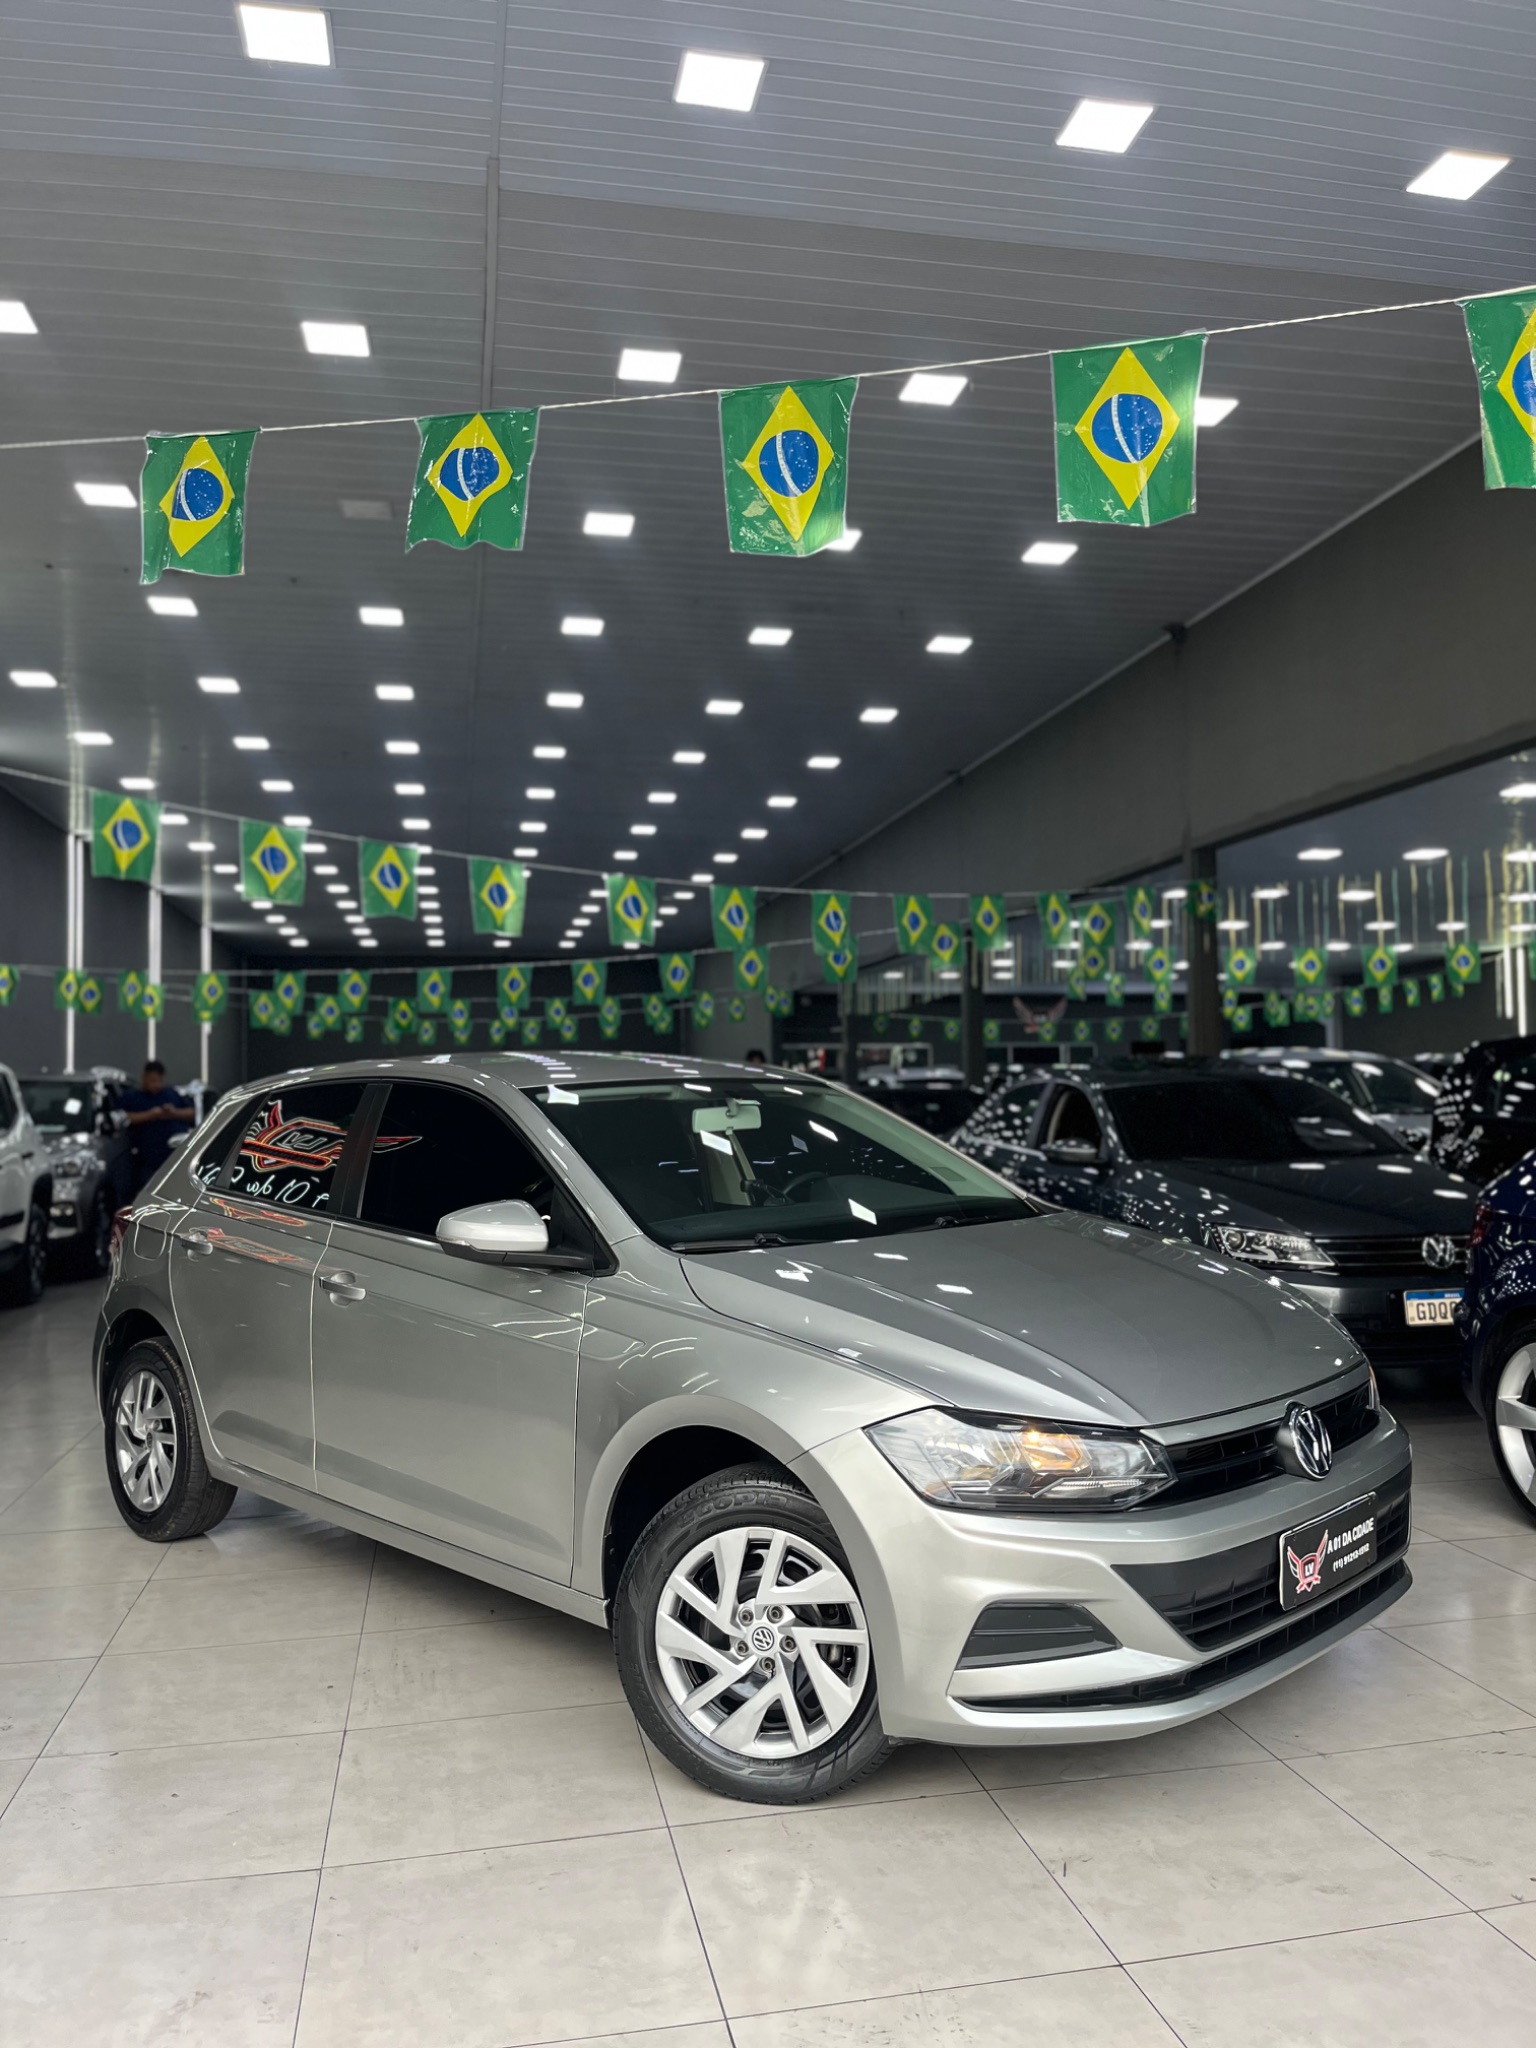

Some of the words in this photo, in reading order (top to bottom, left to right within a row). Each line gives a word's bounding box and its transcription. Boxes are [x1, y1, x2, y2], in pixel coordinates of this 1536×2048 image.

[1334, 1535, 1342, 1551] 01
[1342, 1530, 1353, 1546] DA
[1353, 1517, 1375, 1541] CIDADE
